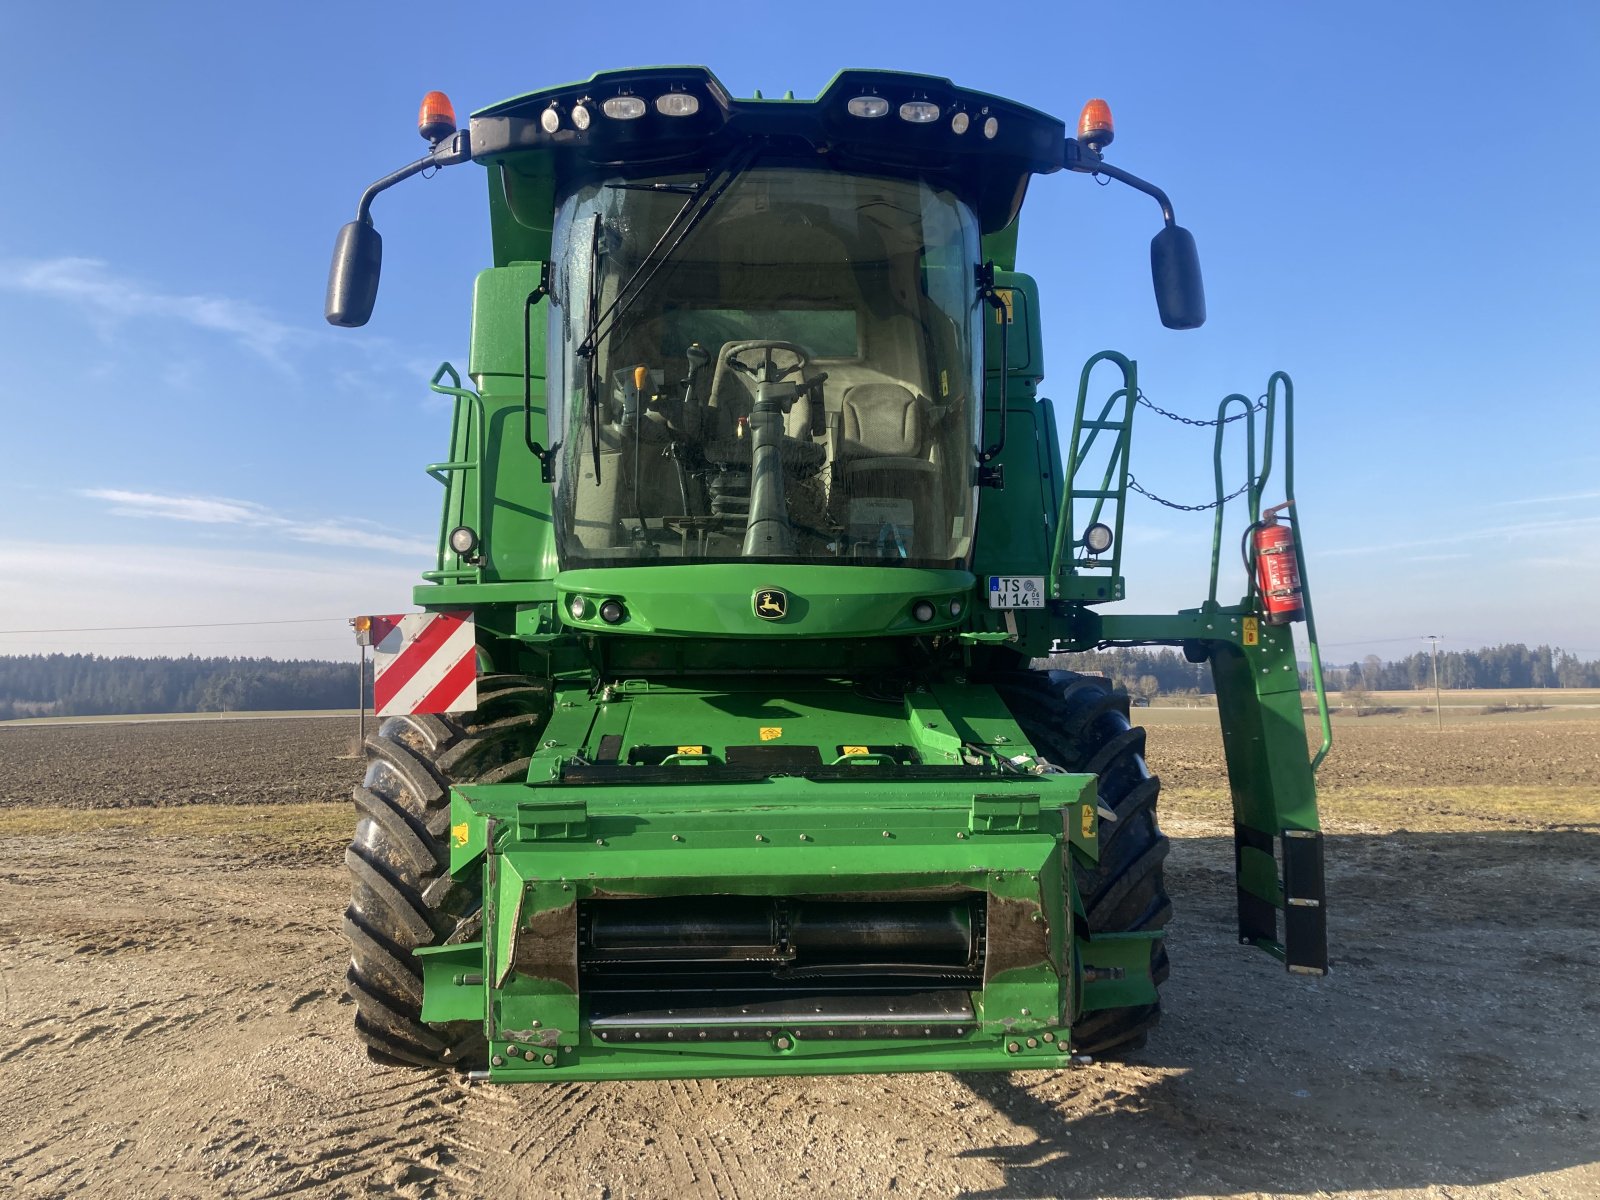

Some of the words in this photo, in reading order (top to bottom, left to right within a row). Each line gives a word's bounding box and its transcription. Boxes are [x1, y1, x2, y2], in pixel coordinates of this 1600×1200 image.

[1002, 579, 1020, 592] TS
[998, 593, 1006, 606] M
[1012, 593, 1029, 606] 14
